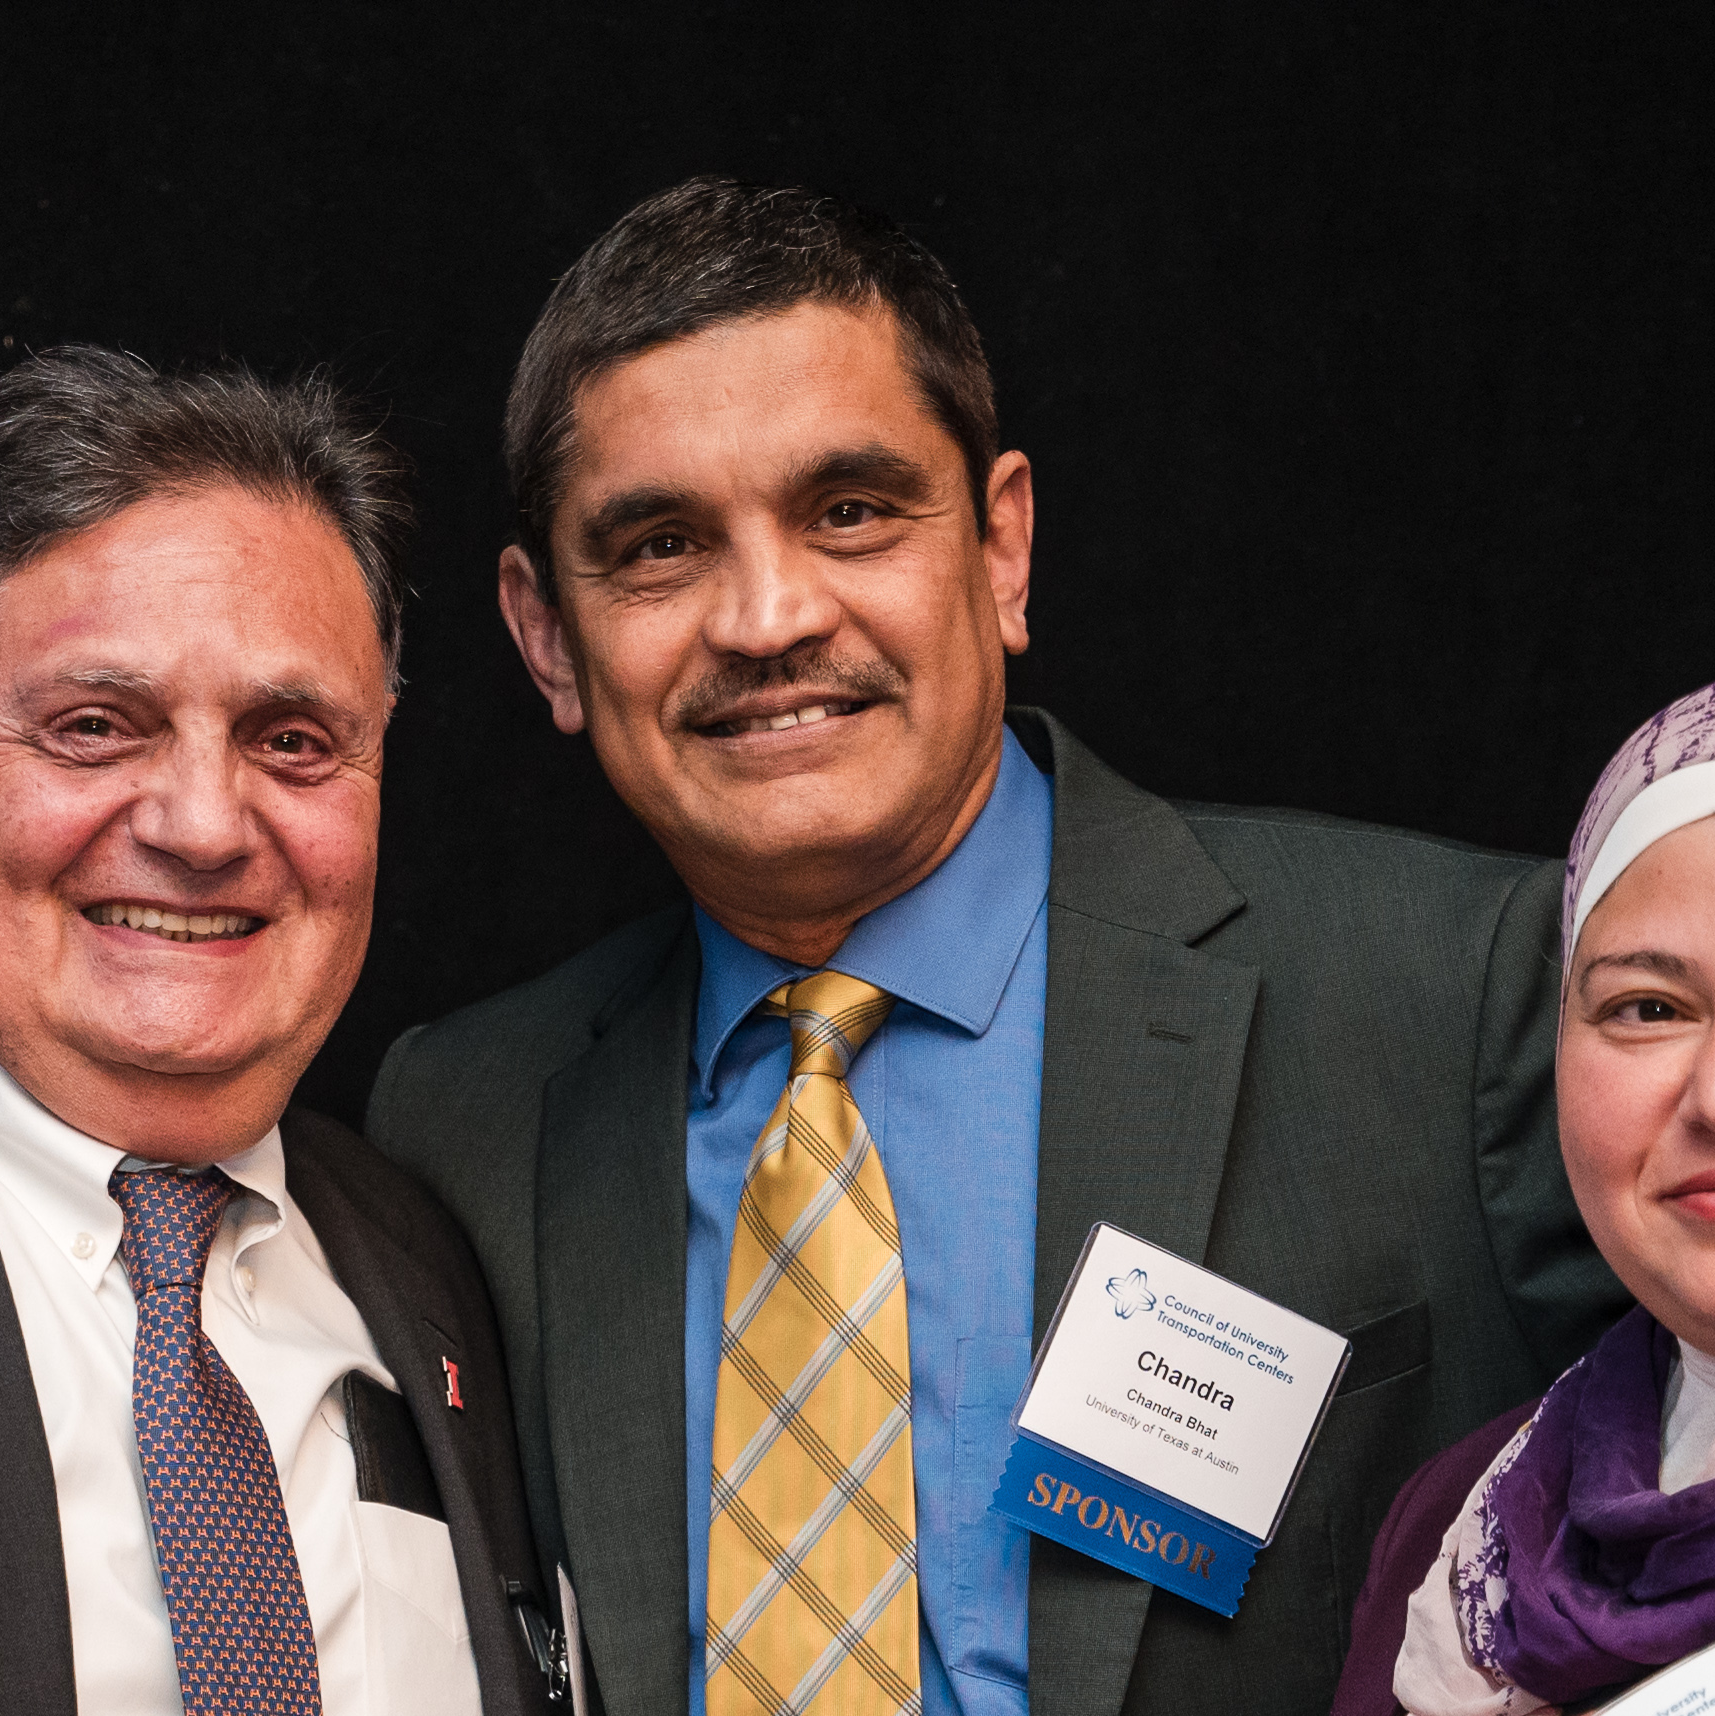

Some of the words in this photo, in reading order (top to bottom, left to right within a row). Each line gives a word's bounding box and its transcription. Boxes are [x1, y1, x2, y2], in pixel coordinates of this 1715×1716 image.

[1157, 1310, 1245, 1361] Transportation
[1247, 1353, 1294, 1385] Centers
[1164, 1294, 1215, 1326] Council
[1215, 1321, 1231, 1333] of
[1230, 1325, 1289, 1364] University
[1126, 1388, 1183, 1424] Chandra
[1185, 1415, 1218, 1441] Bhat
[1137, 1350, 1235, 1412] Chandra
[1085, 1394, 1141, 1430] University
[1142, 1423, 1156, 1434] of
[1157, 1426, 1190, 1452] Texas
[1191, 1446, 1204, 1459] at
[1204, 1451, 1240, 1475] Austin
[1028, 1472, 1217, 1580] SPONSOR
